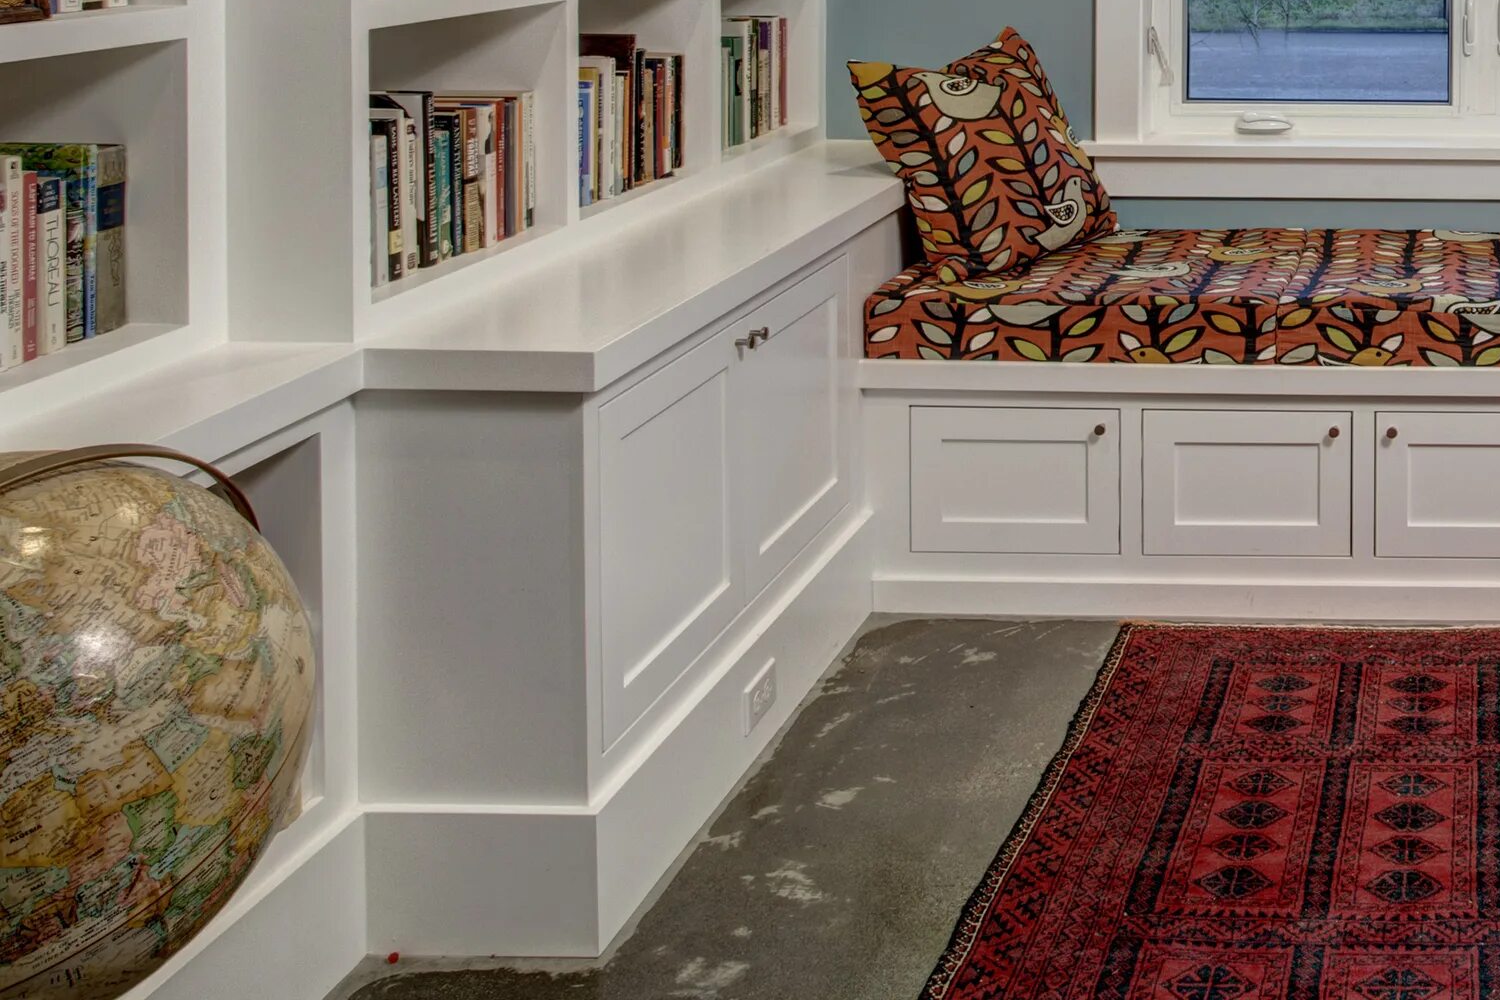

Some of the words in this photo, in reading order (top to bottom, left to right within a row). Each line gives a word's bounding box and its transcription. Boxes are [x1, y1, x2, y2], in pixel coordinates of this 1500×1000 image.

[10, 190, 19, 215] SONGS
[28, 183, 36, 203] LAST
[28, 206, 36, 228] TRAIN
[10, 247, 19, 285] DOOMED
[46, 214, 60, 307] THOREAU
[9, 824, 43, 844] ALGERIA
[30, 881, 47, 892] MALI
